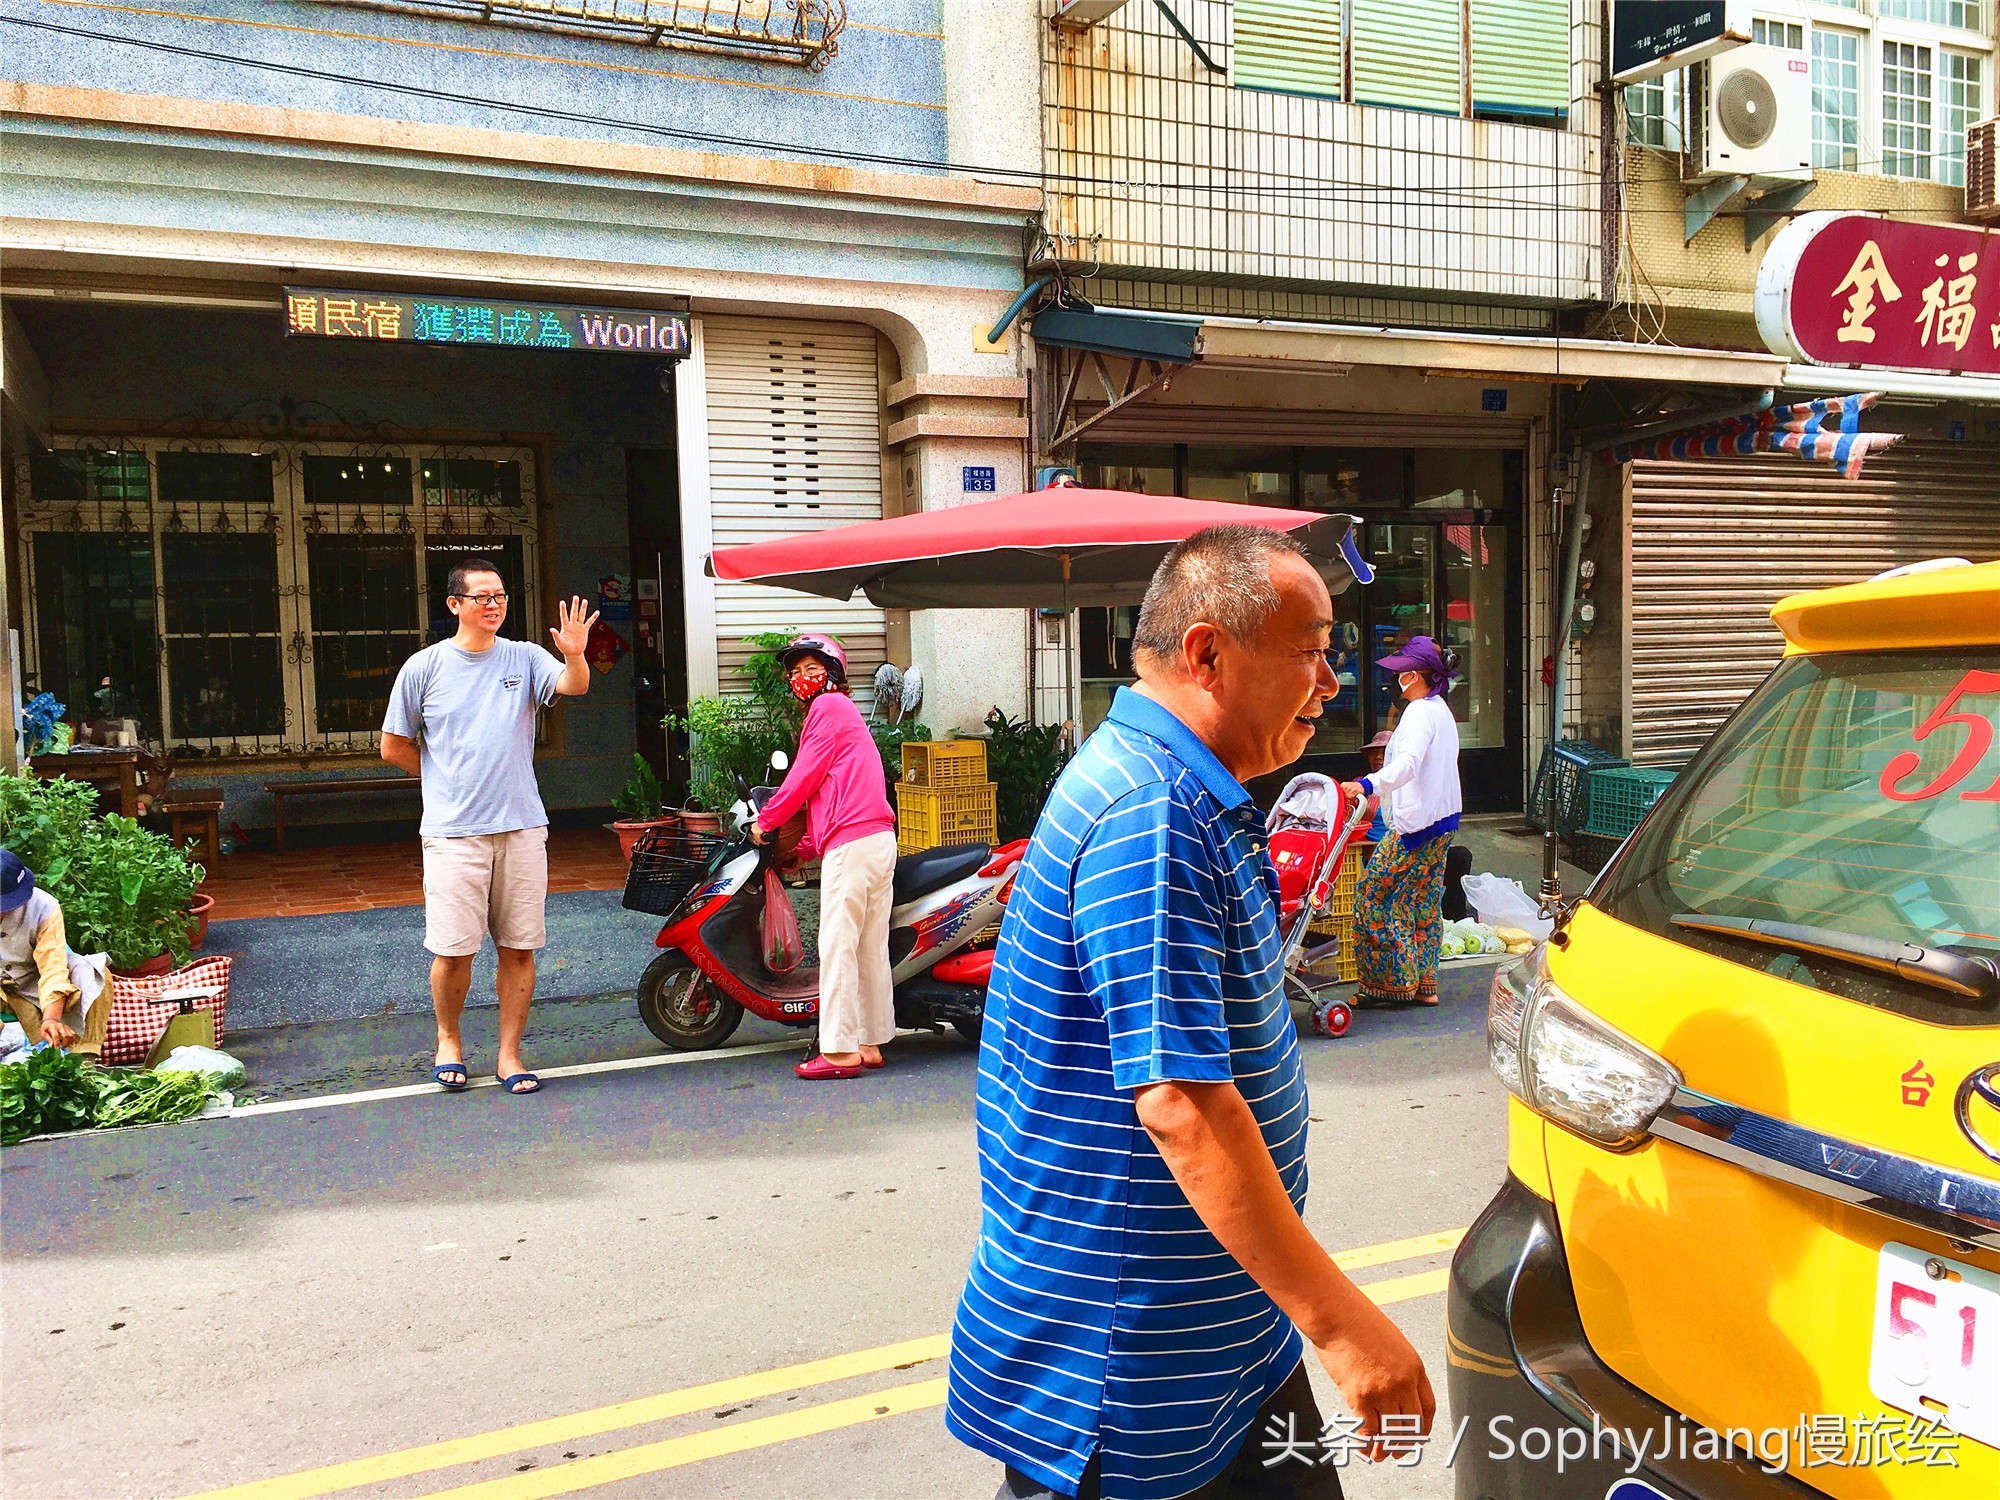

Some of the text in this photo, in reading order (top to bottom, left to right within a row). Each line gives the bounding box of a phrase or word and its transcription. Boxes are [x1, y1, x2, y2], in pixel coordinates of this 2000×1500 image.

[1831, 239, 2000, 352] 金福
[412, 302, 573, 350] 獲選成為
[973, 480, 992, 491] 35
[690, 945, 769, 1016] KYMCO
[783, 1002, 805, 1014] elf
[1901, 1059, 1935, 1108] 台
[1889, 1281, 1977, 1409] 51
